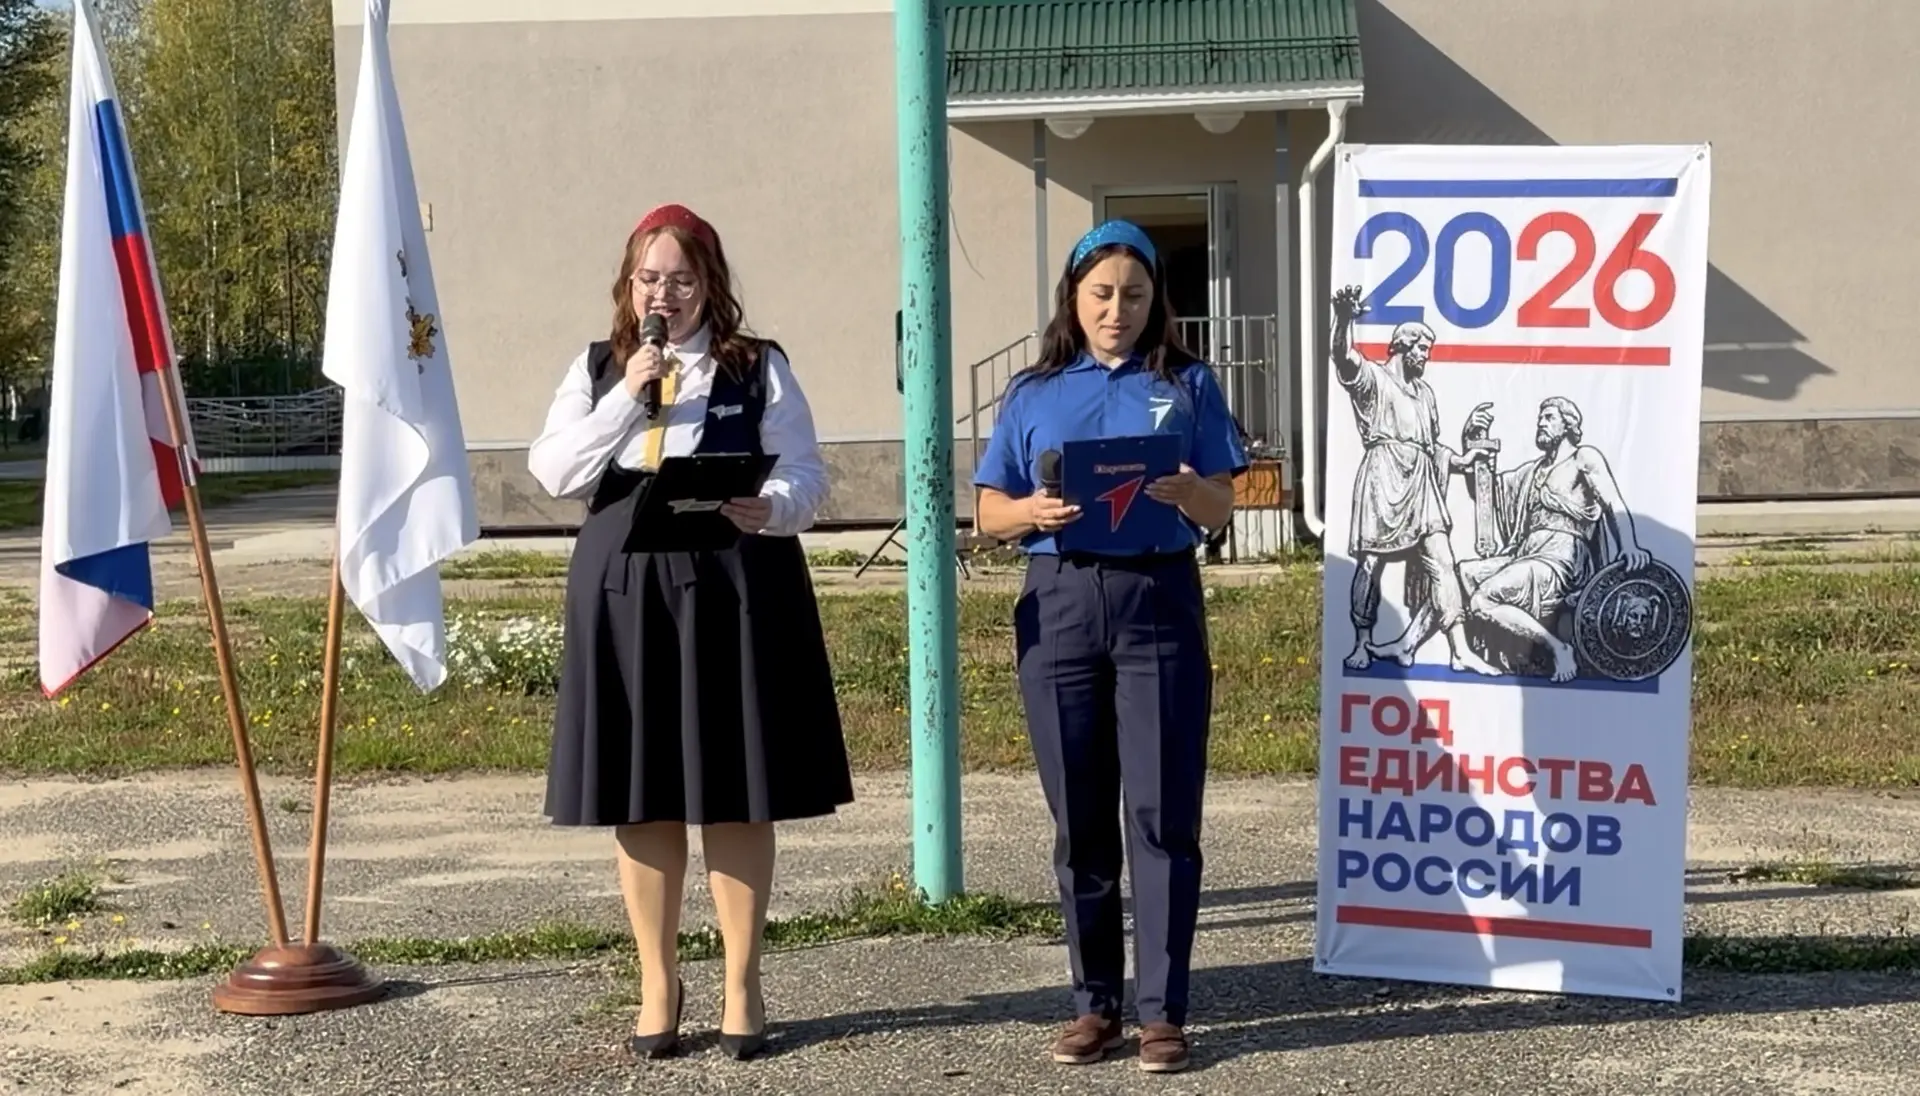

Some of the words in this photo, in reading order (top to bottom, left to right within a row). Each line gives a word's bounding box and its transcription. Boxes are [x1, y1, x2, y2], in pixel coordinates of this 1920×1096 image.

[1354, 212, 1676, 330] 2026
[1341, 694, 1453, 745] ГОД
[1339, 747, 1657, 805] ЕДИНСТВА
[1338, 798, 1622, 856] НАРОДОВ
[1337, 849, 1581, 906] РОССИИ
